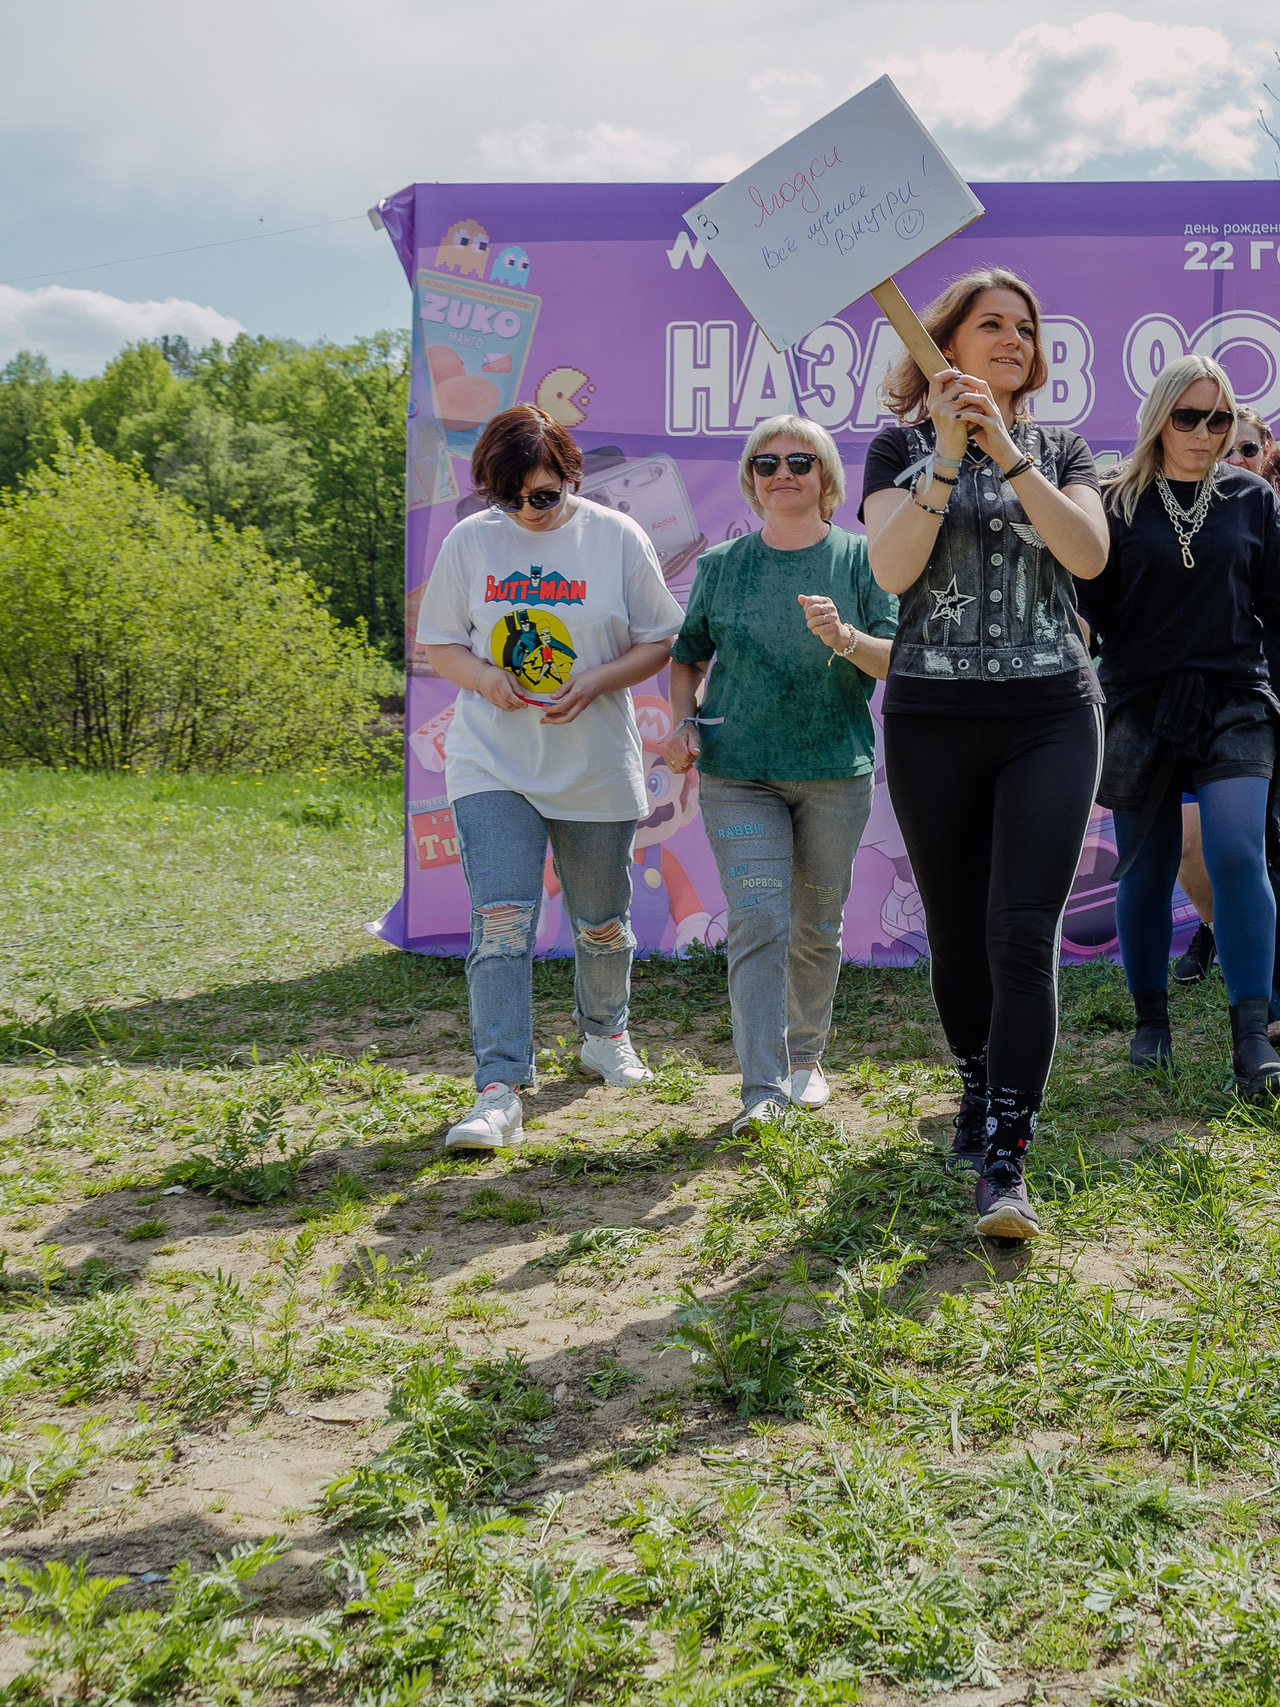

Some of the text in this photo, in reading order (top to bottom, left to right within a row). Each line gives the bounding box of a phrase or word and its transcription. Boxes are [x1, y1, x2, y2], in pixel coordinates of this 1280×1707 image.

[697, 212, 719, 240] 3
[1184, 223, 1219, 235] день
[1184, 241, 1234, 270] 22
[419, 292, 522, 340] ZUKO
[448, 330, 484, 350] МАНГО
[666, 318, 908, 436] НАЗА
[1024, 314, 1096, 430] В
[651, 514, 678, 530] Kodak
[485, 575, 587, 602] BUTT-MAN
[717, 823, 766, 839] RABBIT
[729, 864, 749, 877] BUT
